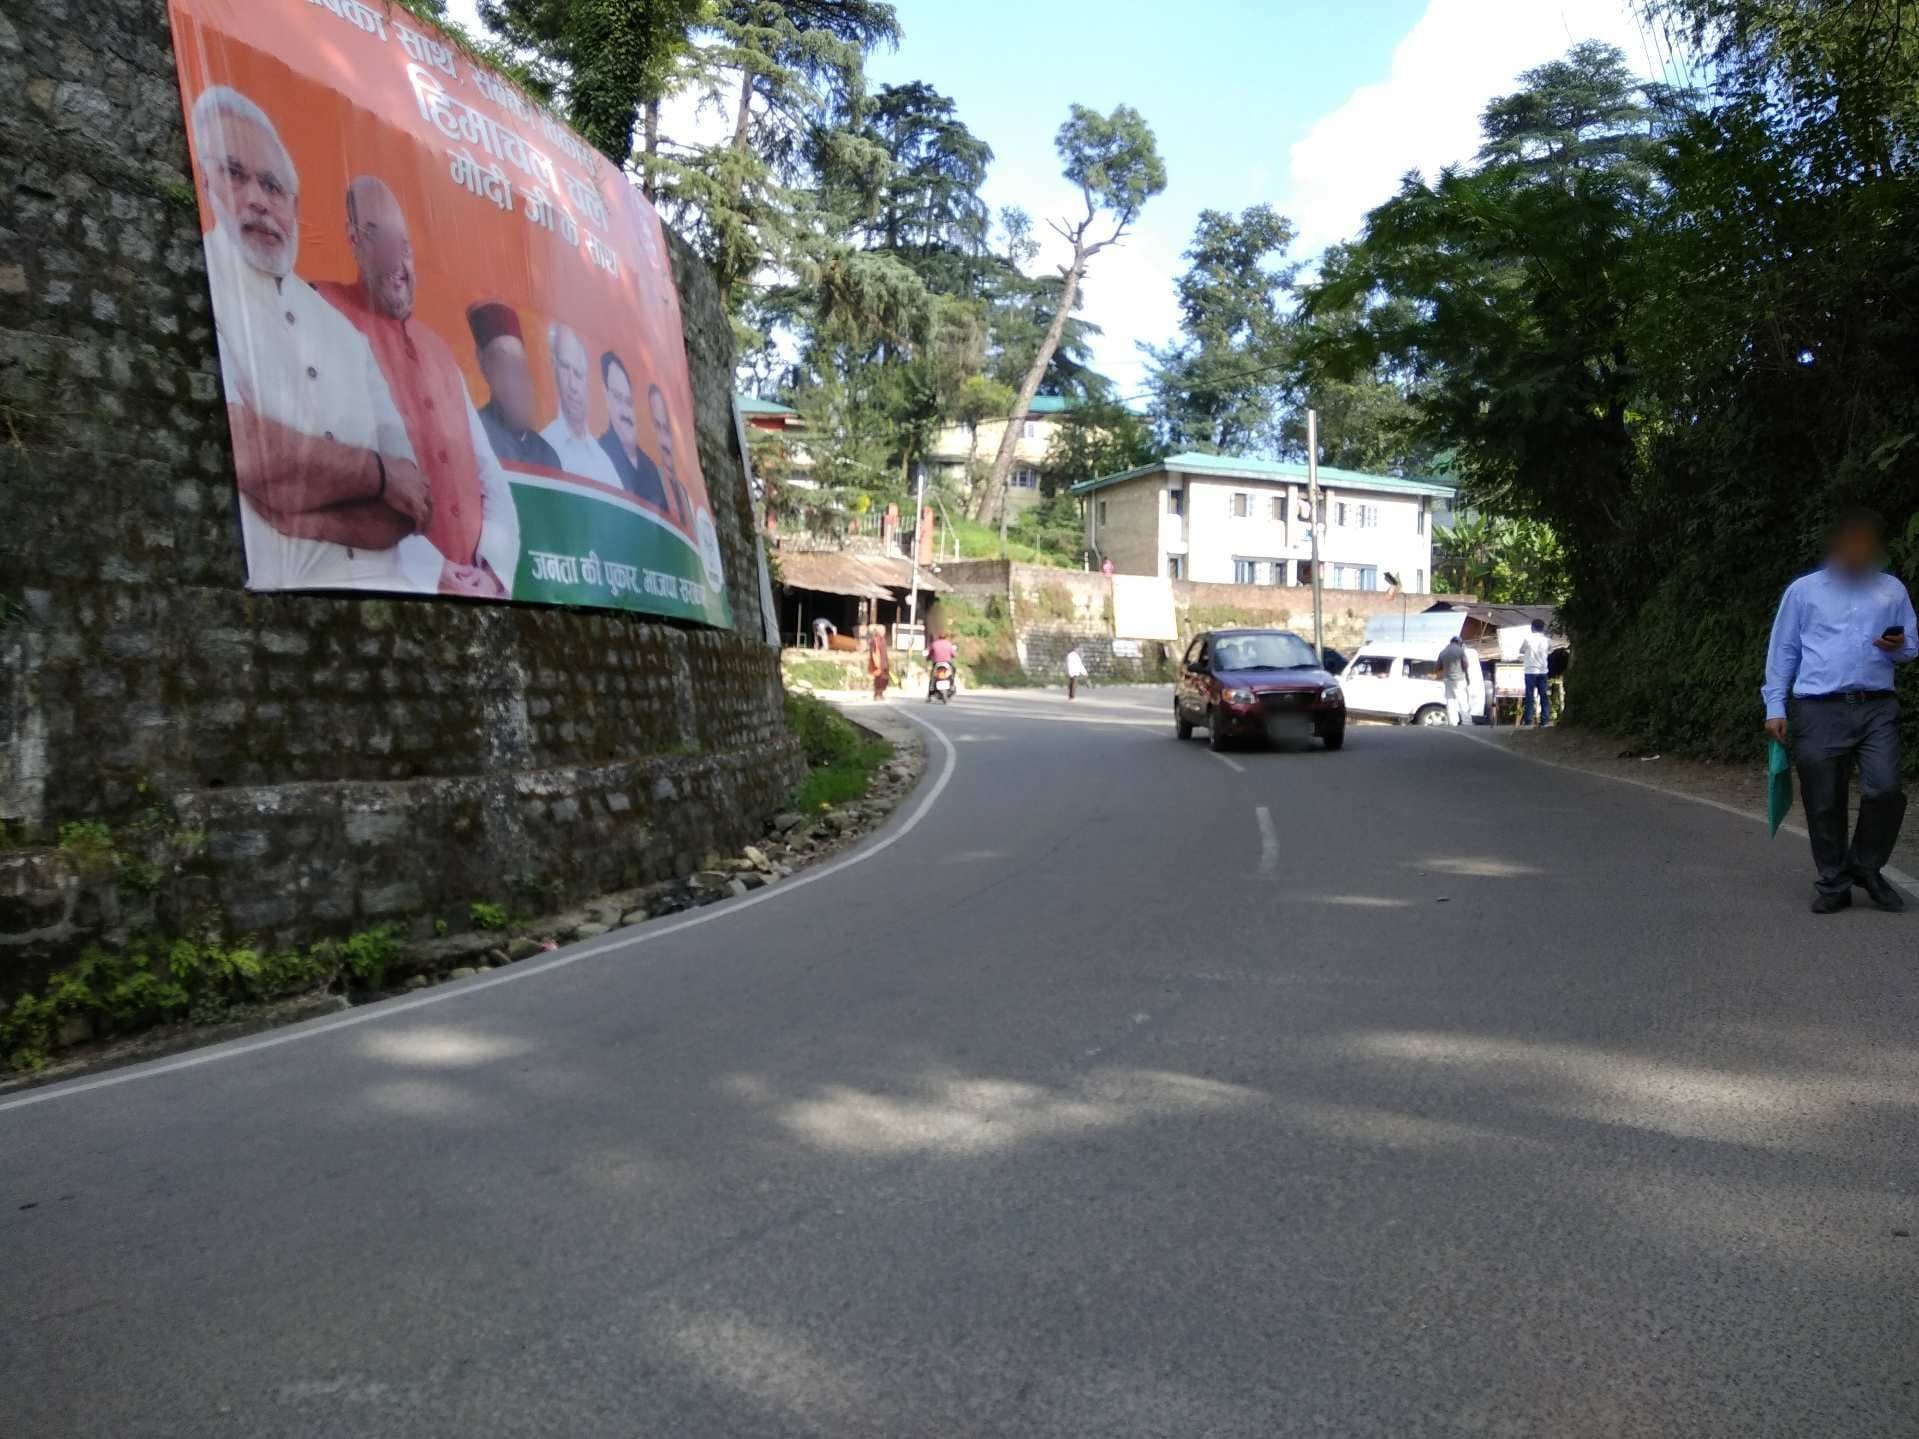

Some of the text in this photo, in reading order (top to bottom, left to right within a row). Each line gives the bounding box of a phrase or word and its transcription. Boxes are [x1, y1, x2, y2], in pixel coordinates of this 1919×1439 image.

[306, 0, 388, 41] बका
[406, 63, 561, 196] हिमाचल
[447, 148, 619, 279] मोदी जी के साथ
[528, 550, 579, 584] जनता
[579, 551, 601, 586] की
